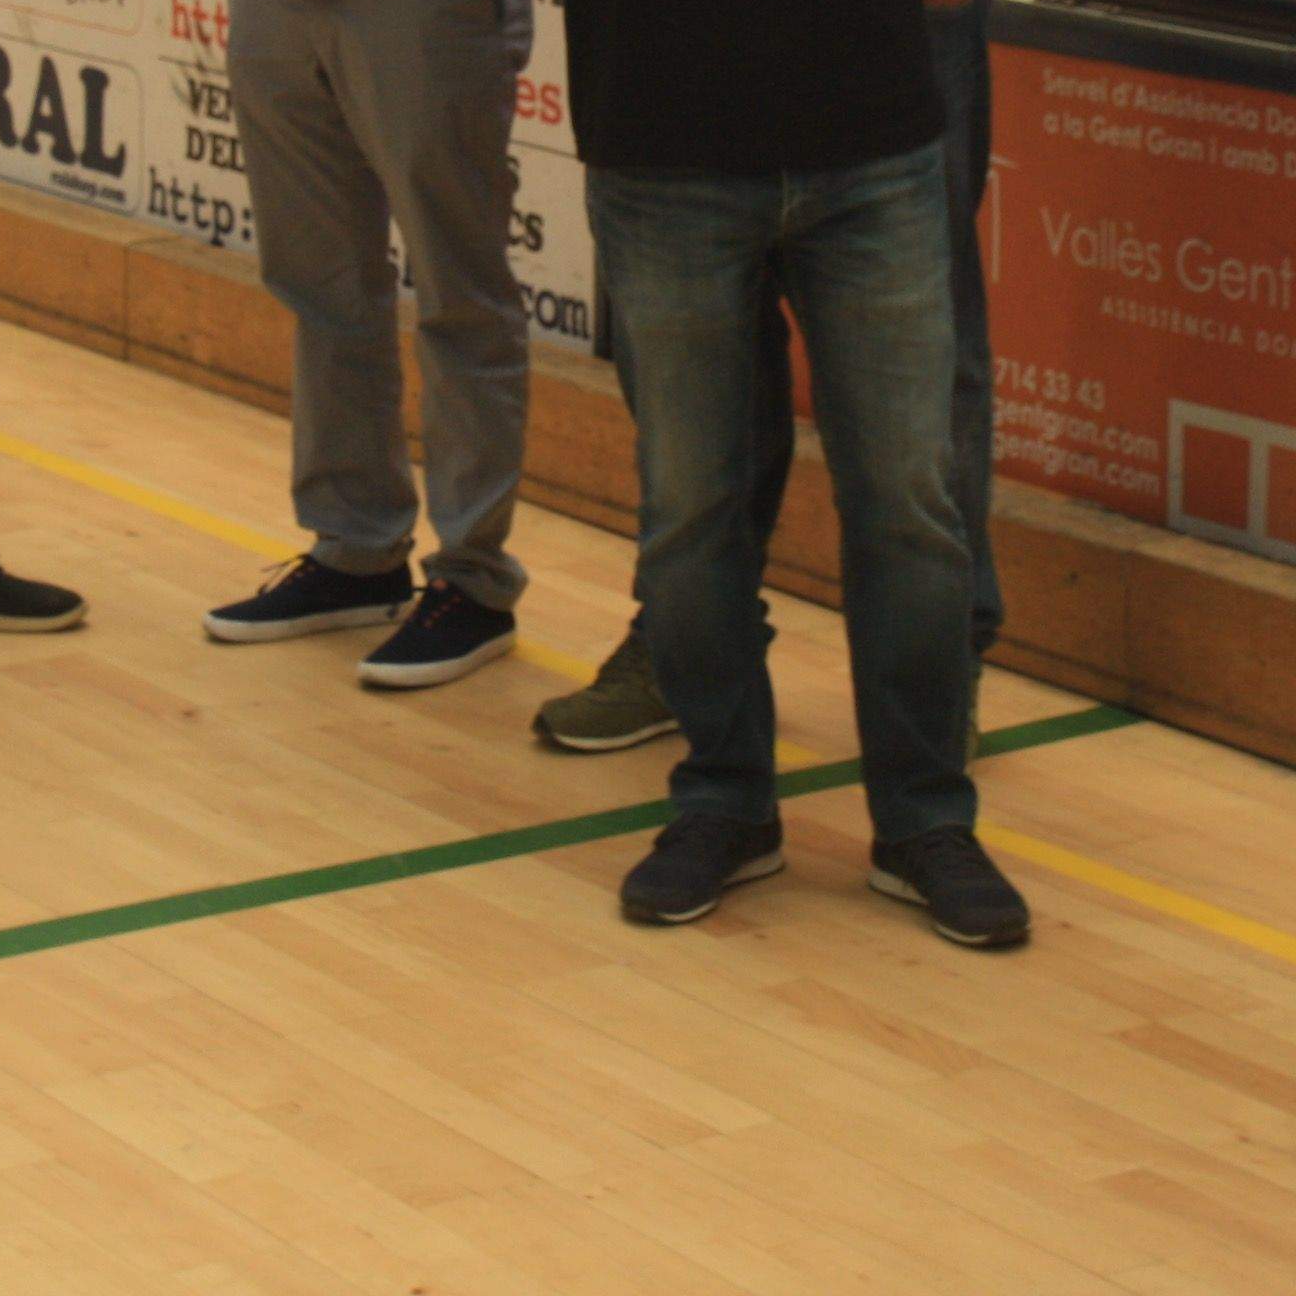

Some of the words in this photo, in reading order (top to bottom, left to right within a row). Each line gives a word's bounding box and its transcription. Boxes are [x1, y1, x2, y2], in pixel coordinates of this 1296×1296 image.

[1146, 125, 1203, 160] Gran
[1040, 206, 1163, 284] Vallès
[1175, 236, 1296, 311] Gent
